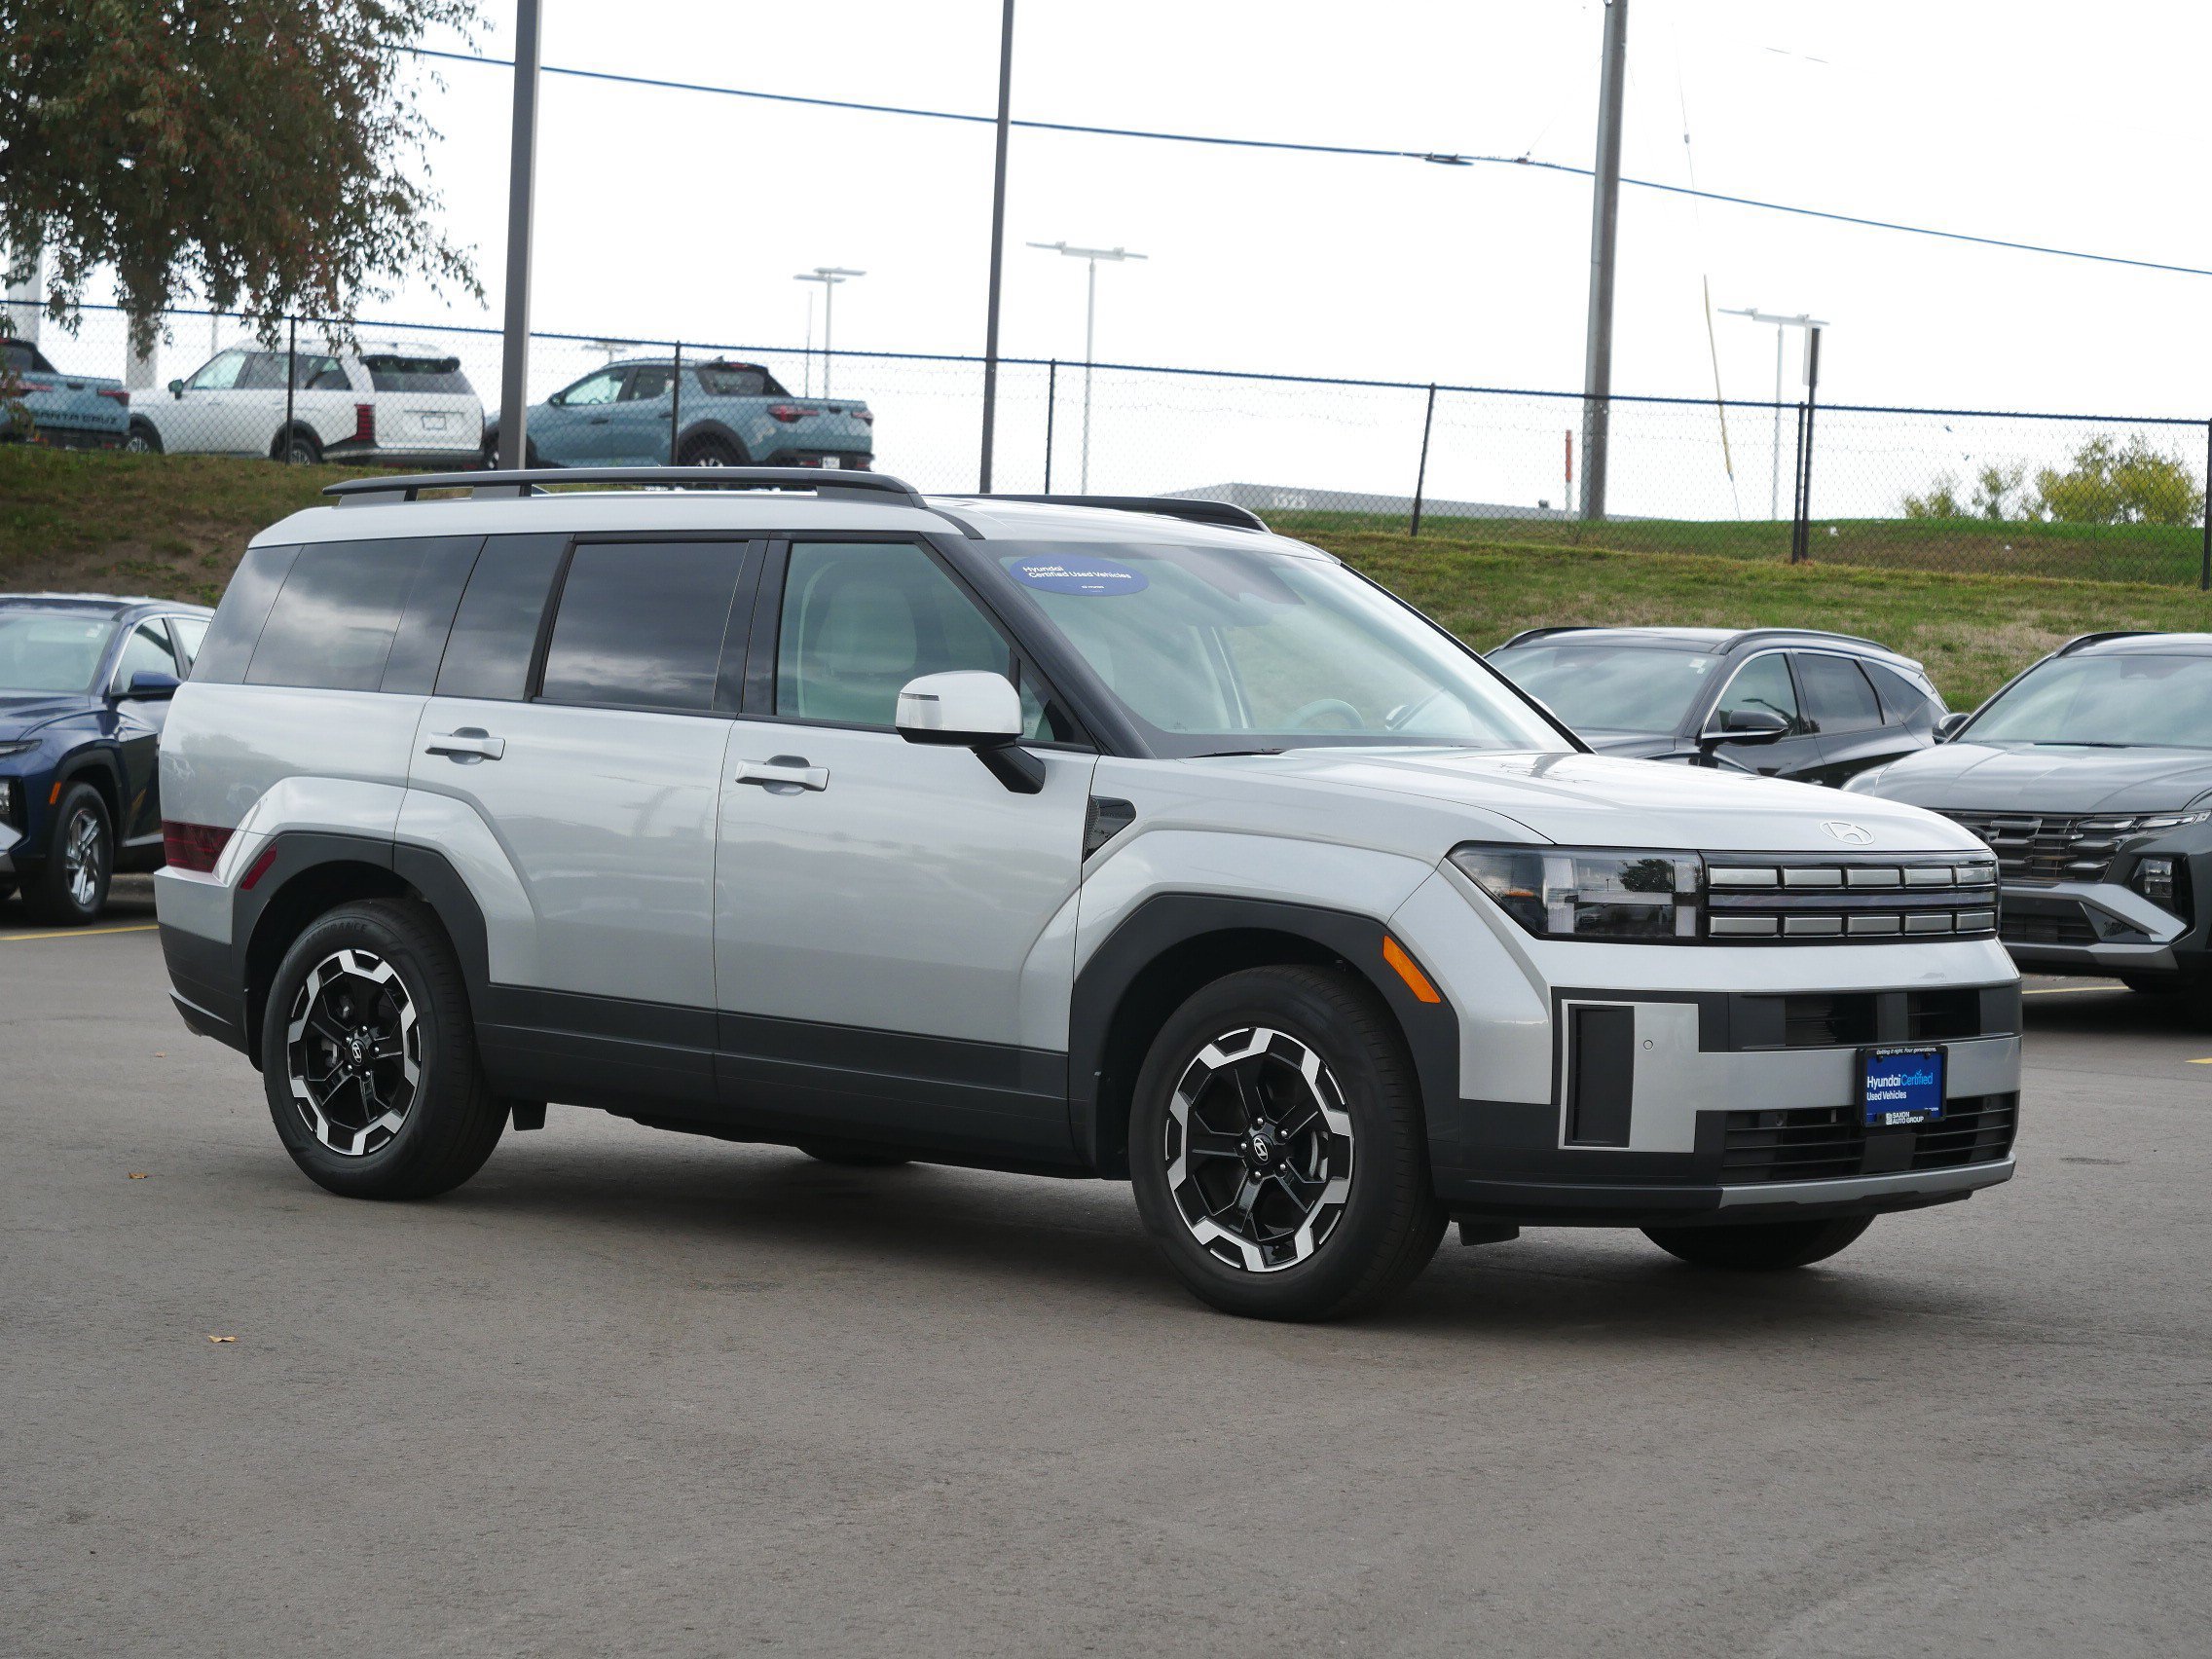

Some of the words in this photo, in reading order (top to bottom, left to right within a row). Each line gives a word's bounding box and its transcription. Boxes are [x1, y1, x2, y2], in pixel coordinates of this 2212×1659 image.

[1866, 1073, 1901, 1090] Hyundai
[1900, 1070, 1934, 1087] Certified
[1866, 1090, 1882, 1101] Used
[1882, 1089, 1907, 1100] Vehicles
[1892, 1111, 1910, 1120] SAXON
